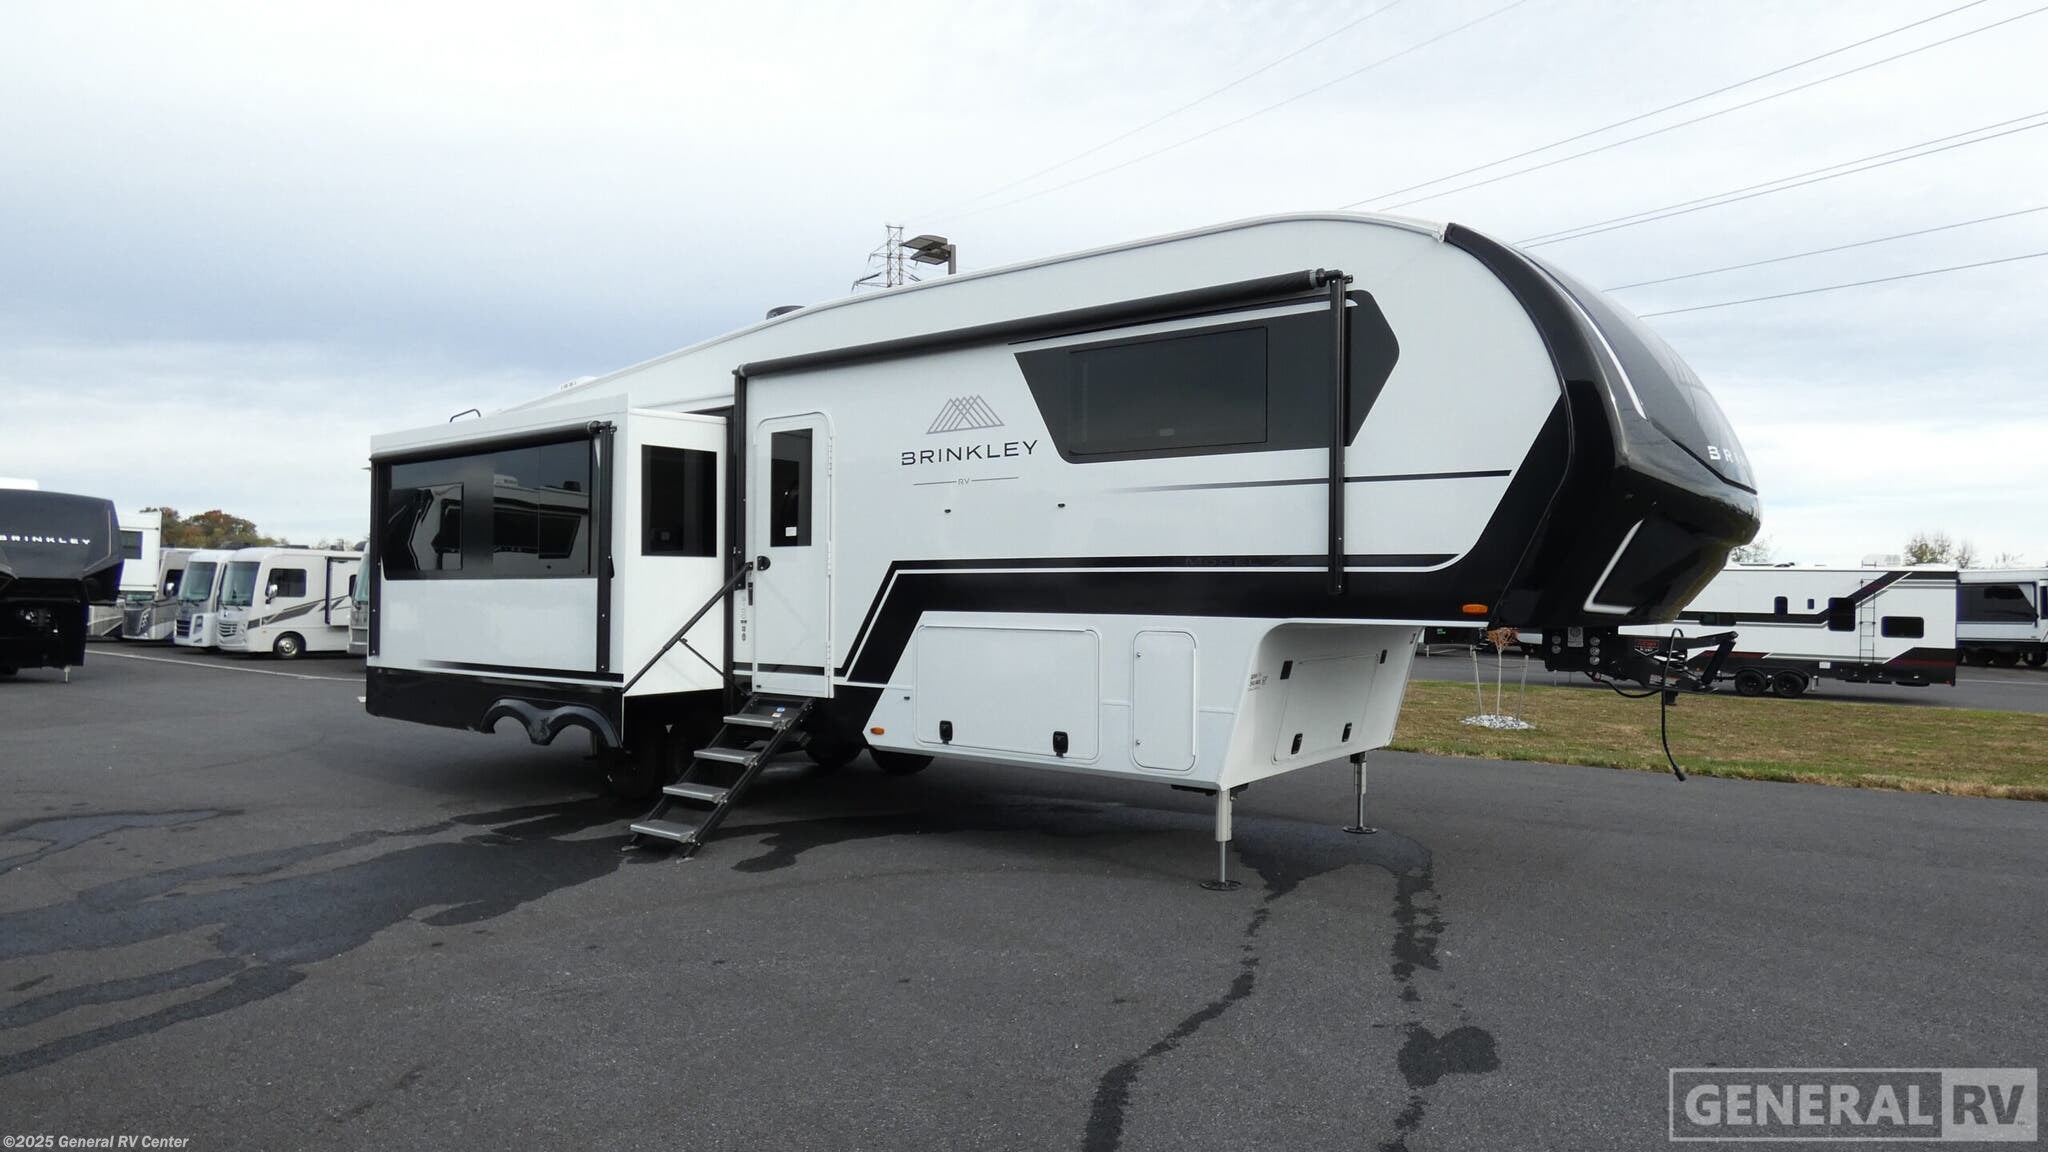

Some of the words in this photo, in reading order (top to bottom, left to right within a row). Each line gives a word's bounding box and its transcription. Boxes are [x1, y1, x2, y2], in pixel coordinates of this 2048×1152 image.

[901, 439, 1038, 466] BRINKLEY
[957, 478, 970, 486] RV
[0, 534, 91, 545] BRINKLEY
